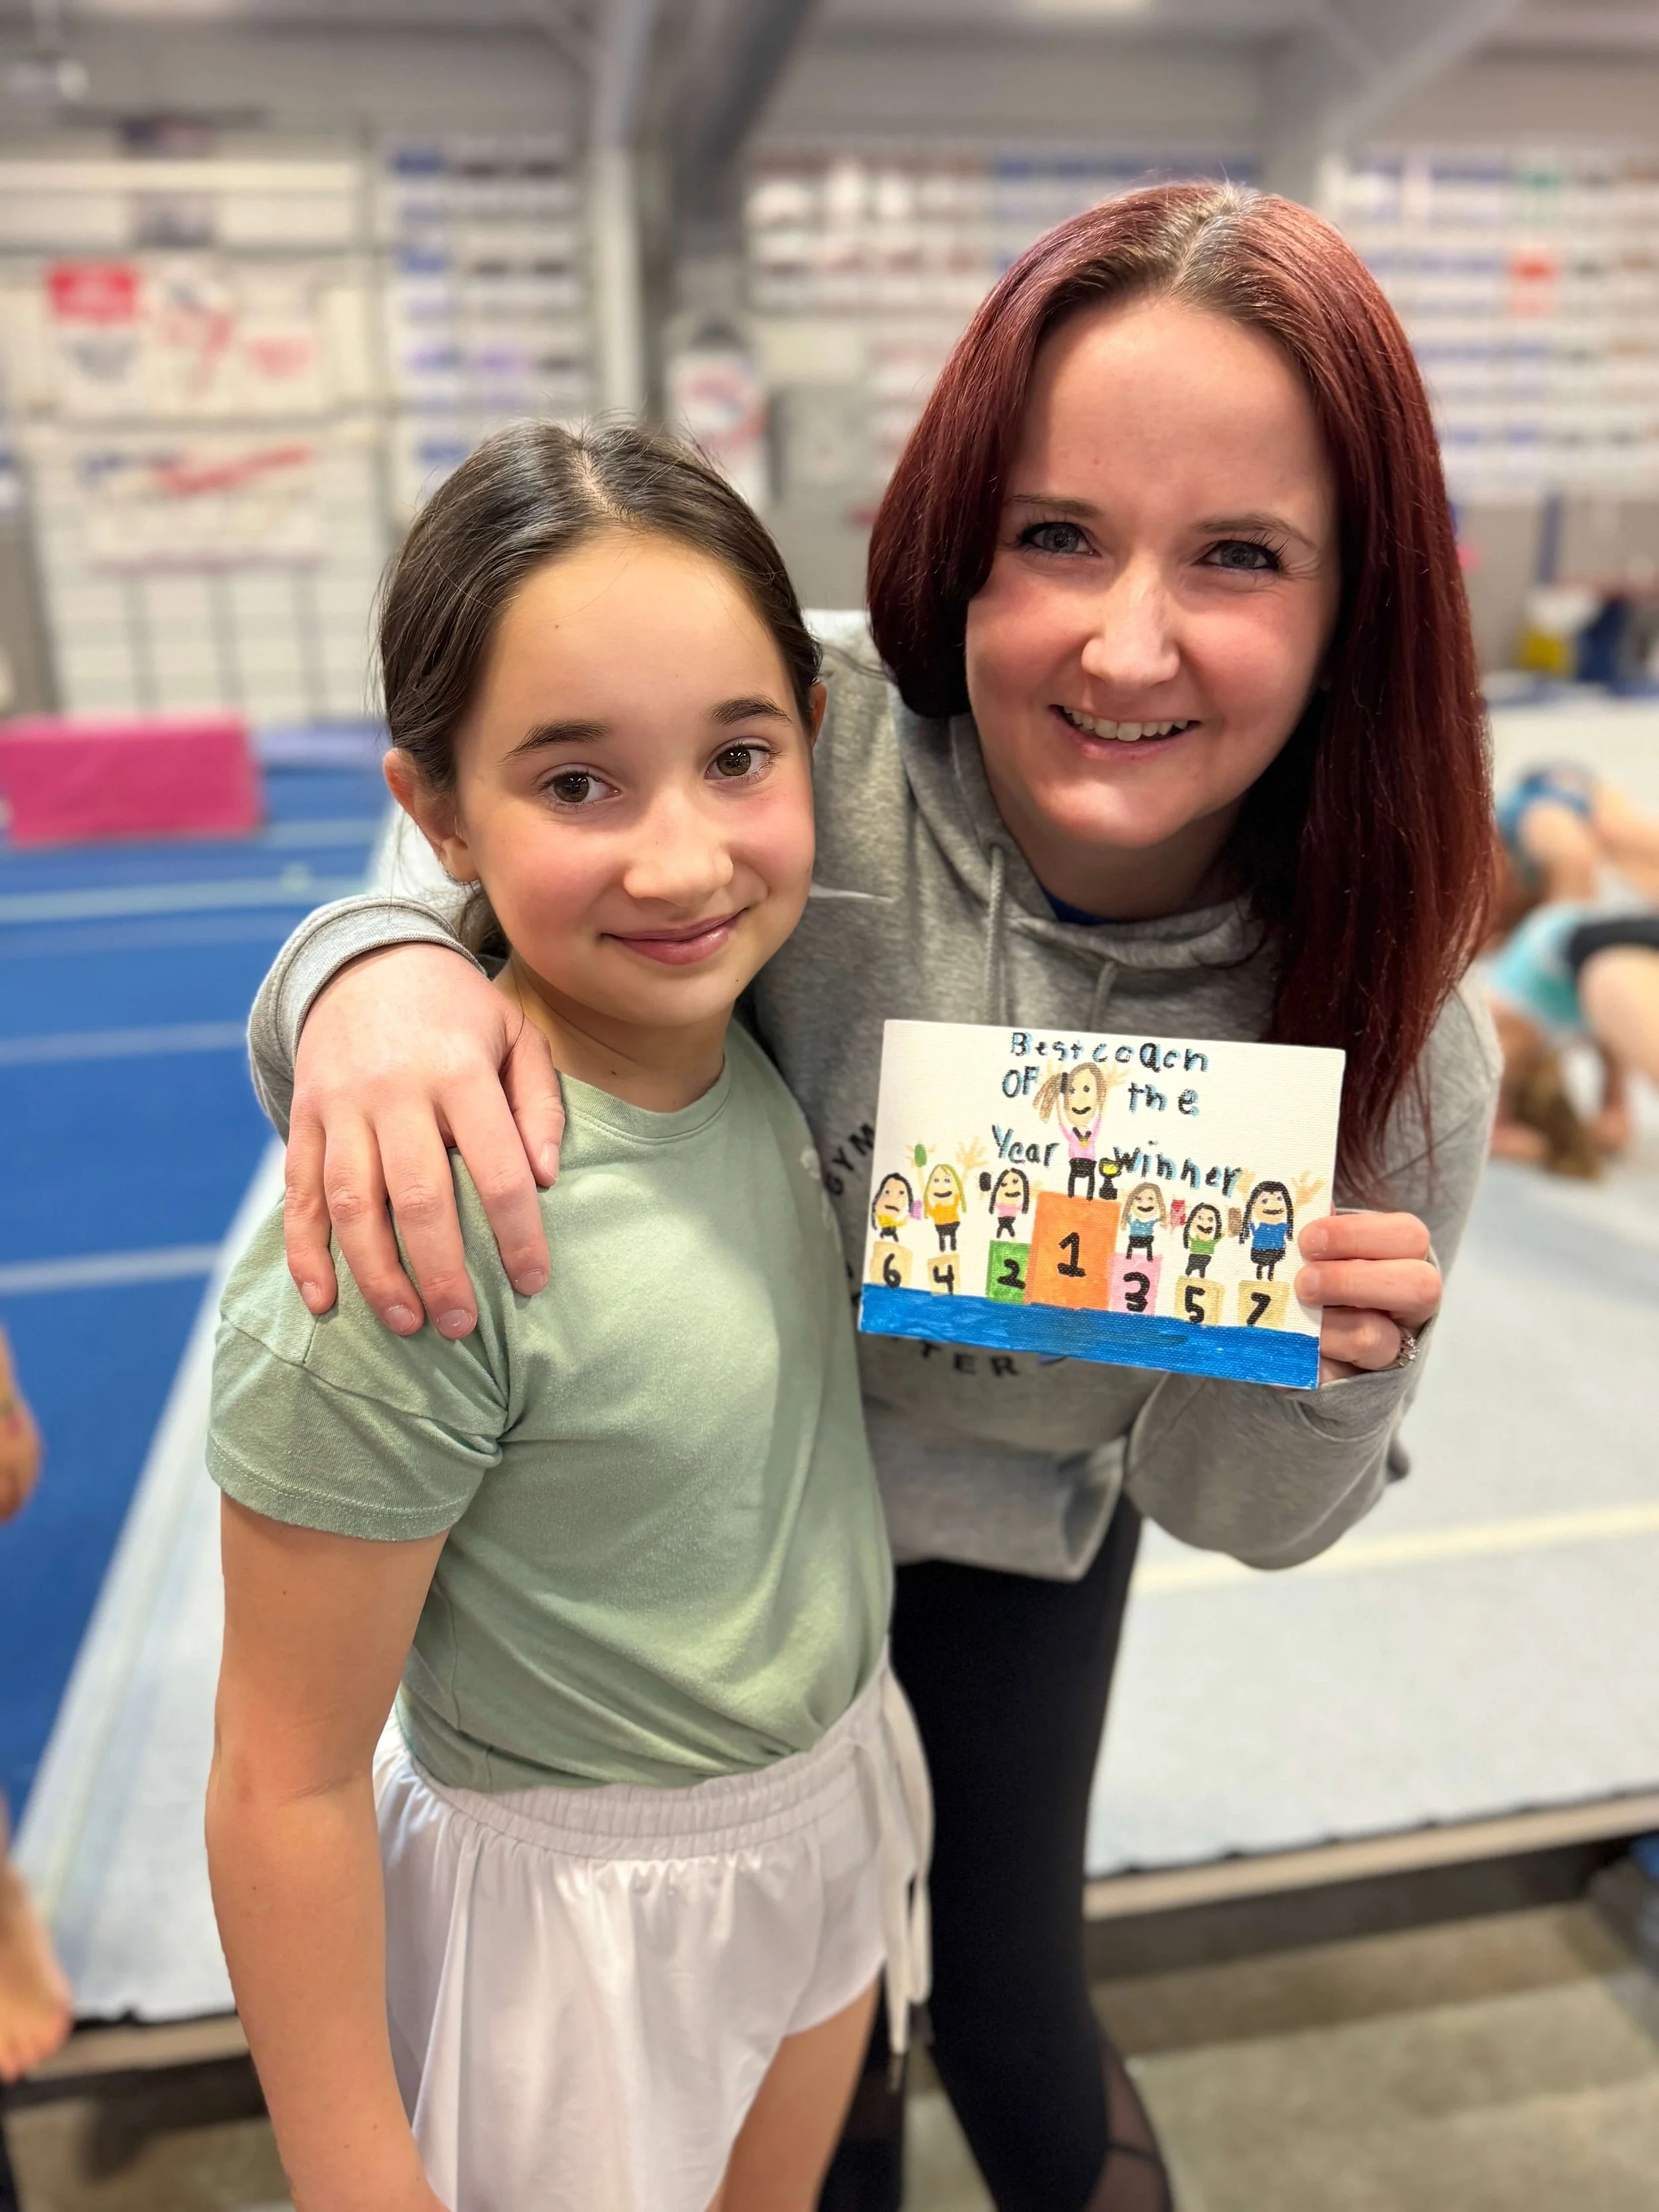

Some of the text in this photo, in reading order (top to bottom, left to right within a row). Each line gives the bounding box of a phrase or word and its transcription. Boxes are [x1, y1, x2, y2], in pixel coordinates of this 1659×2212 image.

[1011, 1032, 1084, 1062] Best
[1128, 1082, 1200, 1117] the
[992, 1124, 1060, 1168] Year
[883, 1253, 902, 1288] 6
[1057, 1232, 1086, 1278] 1
[933, 1264, 954, 1295] 4
[997, 1258, 1026, 1290] 2
[1123, 1271, 1151, 1313] 3
[1185, 1285, 1206, 1324] 5
[1246, 1291, 1272, 1327] 7
[893, 1336, 1019, 1378] TER
